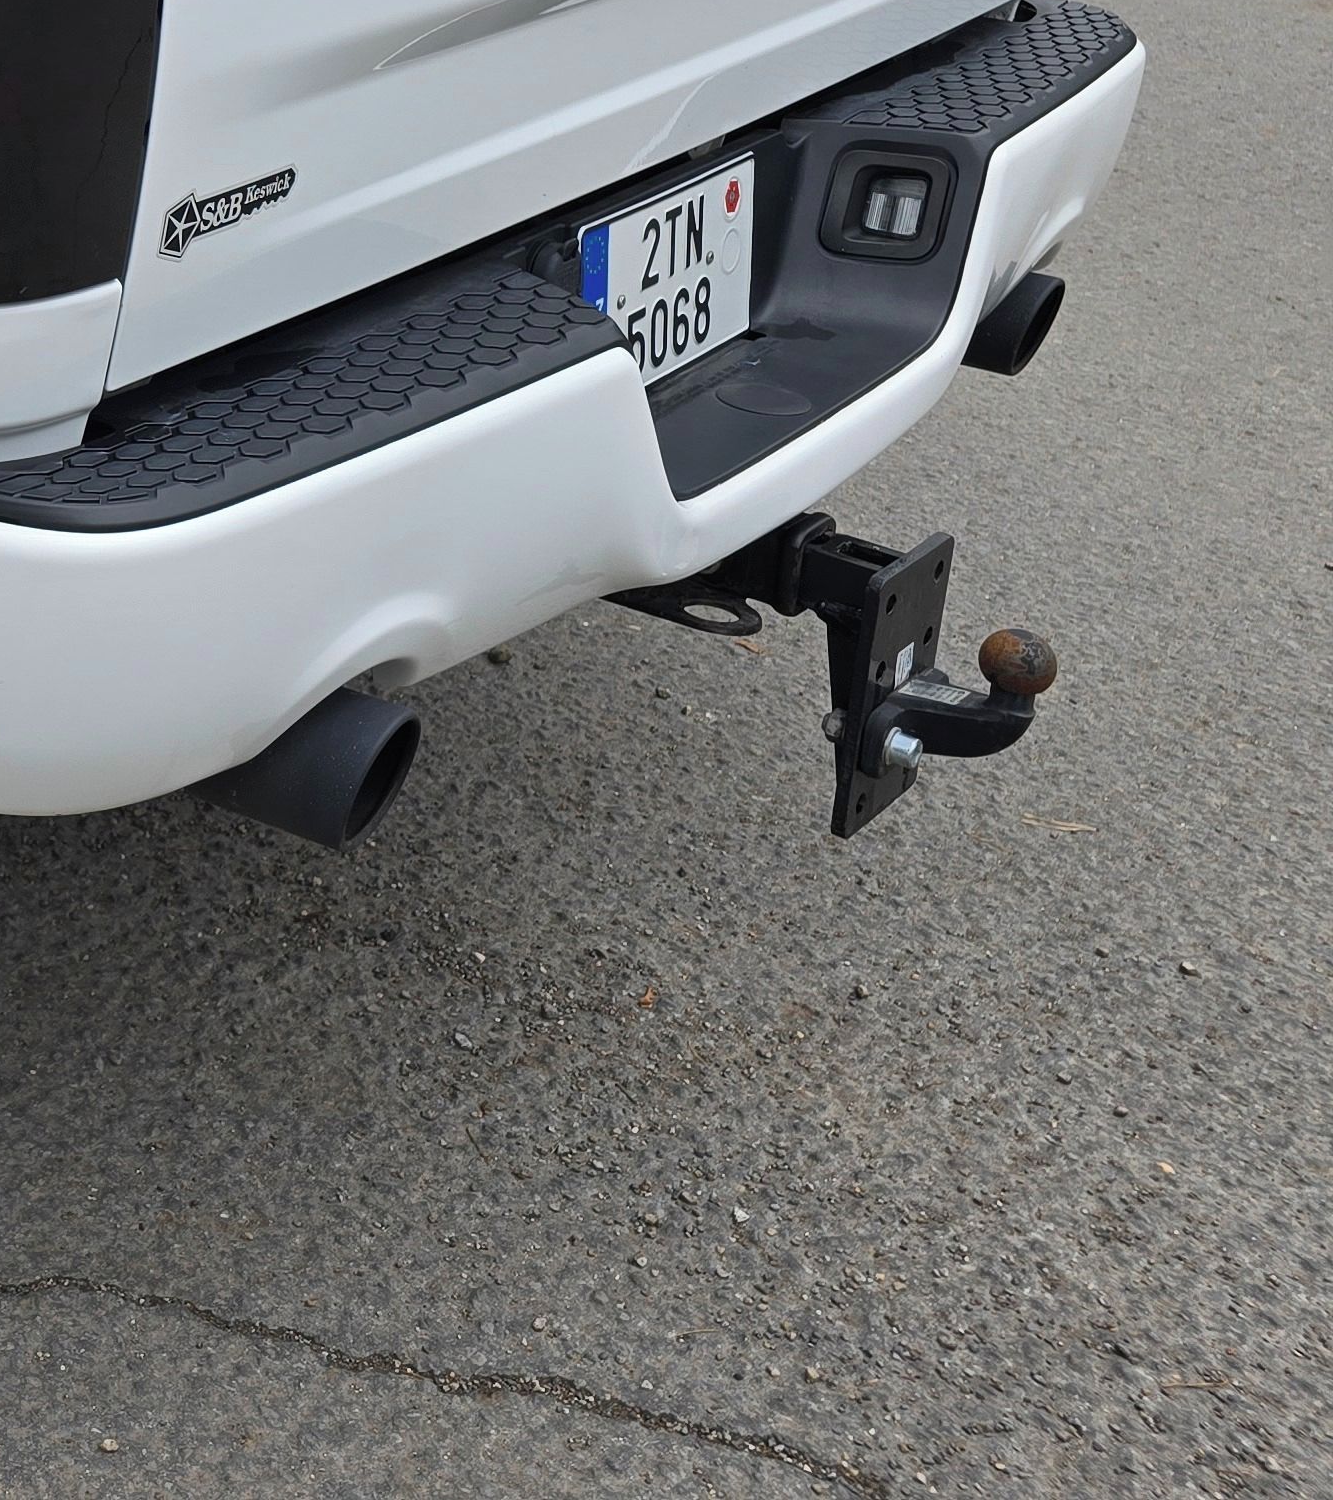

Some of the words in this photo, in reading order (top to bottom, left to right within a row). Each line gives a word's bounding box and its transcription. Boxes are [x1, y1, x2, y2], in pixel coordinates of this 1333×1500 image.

[200, 192, 243, 232] S&B
[244, 172, 292, 205] Keswick
[641, 194, 705, 291] 2TN
[628, 276, 712, 373] 5068
